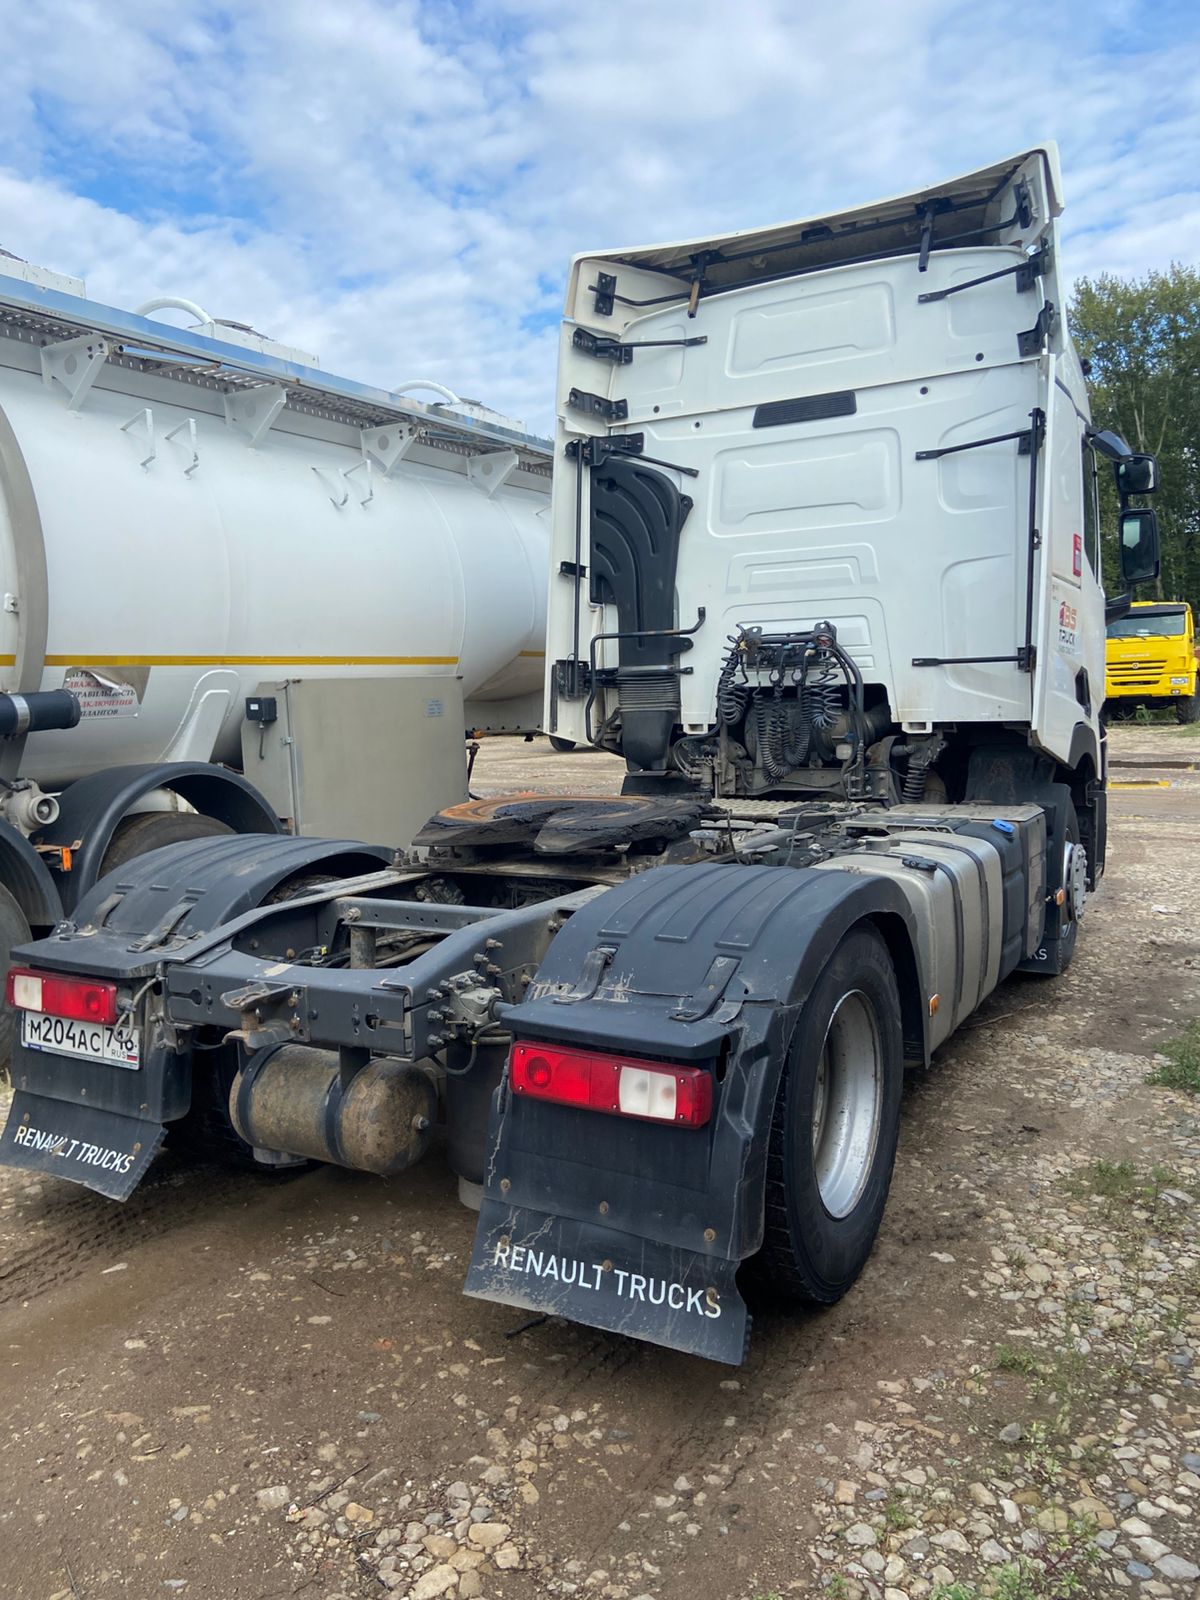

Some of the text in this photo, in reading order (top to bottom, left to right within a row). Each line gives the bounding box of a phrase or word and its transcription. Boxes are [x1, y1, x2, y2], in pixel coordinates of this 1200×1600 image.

[111, 1048, 126, 1059] RUS
[76, 1142, 135, 1174] TRUCKS
[494, 1241, 722, 1319] RENAULT TRUCKS
